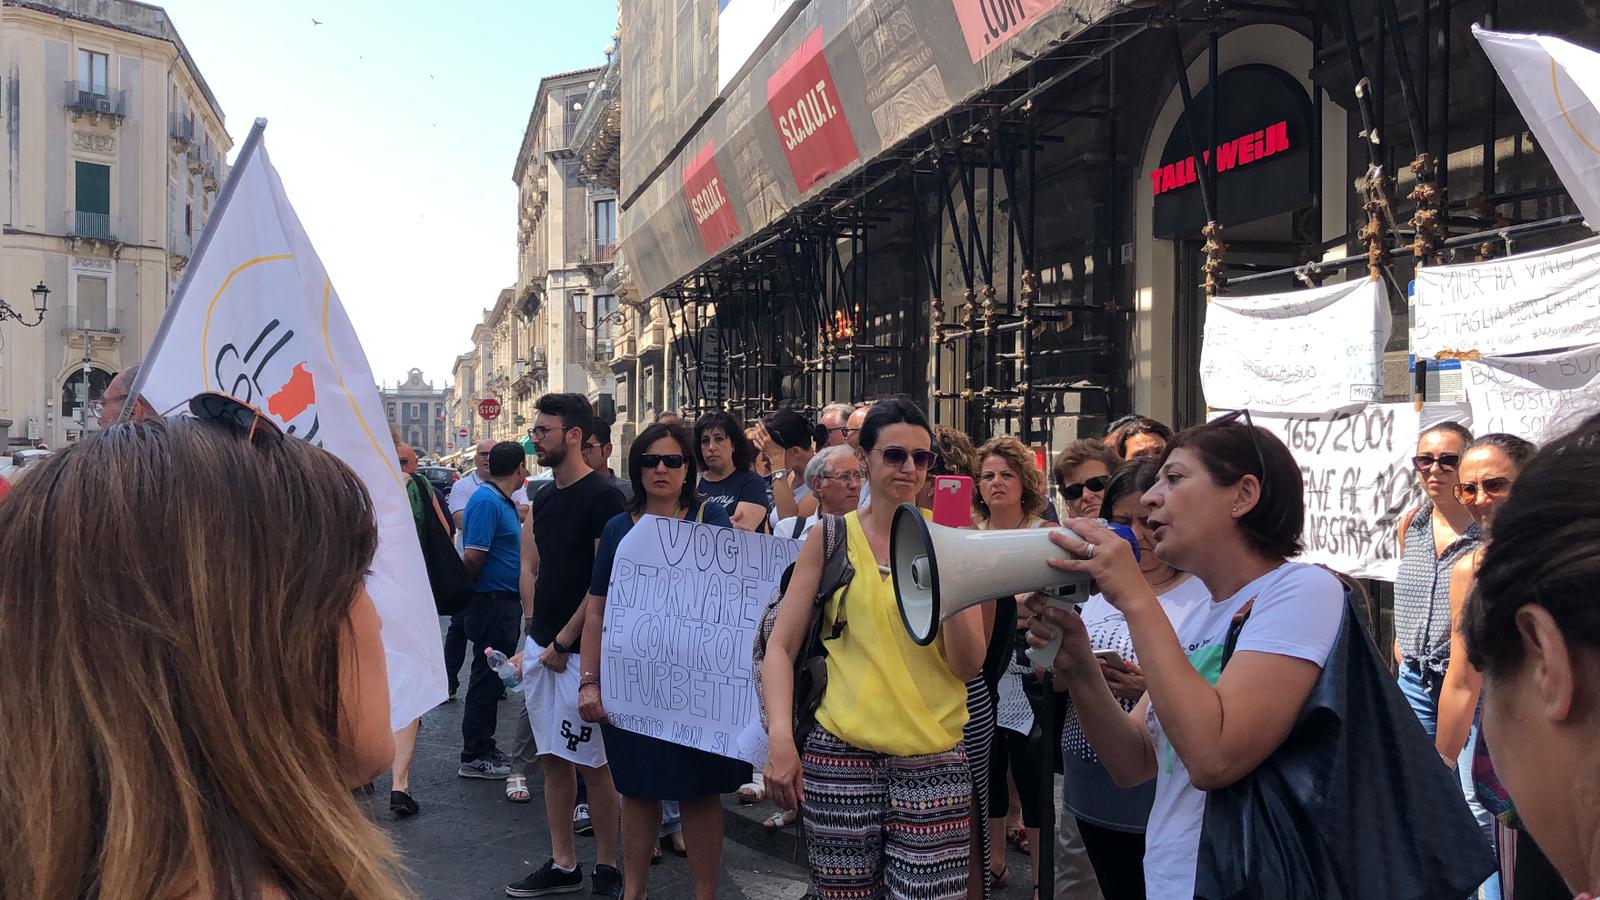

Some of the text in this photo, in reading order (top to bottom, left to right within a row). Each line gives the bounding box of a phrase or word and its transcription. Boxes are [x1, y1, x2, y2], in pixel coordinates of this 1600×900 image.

[1151, 155, 1210, 196] TALL
[479, 405, 500, 414] STOP
[1310, 513, 1372, 559] NOSTRA
[611, 557, 759, 629] RITORNARE
[608, 607, 626, 653] E
[608, 656, 754, 728] I FURBETTI
[607, 711, 664, 737] COMITATO
[671, 721, 703, 749] NON
[711, 731, 730, 756] SI
